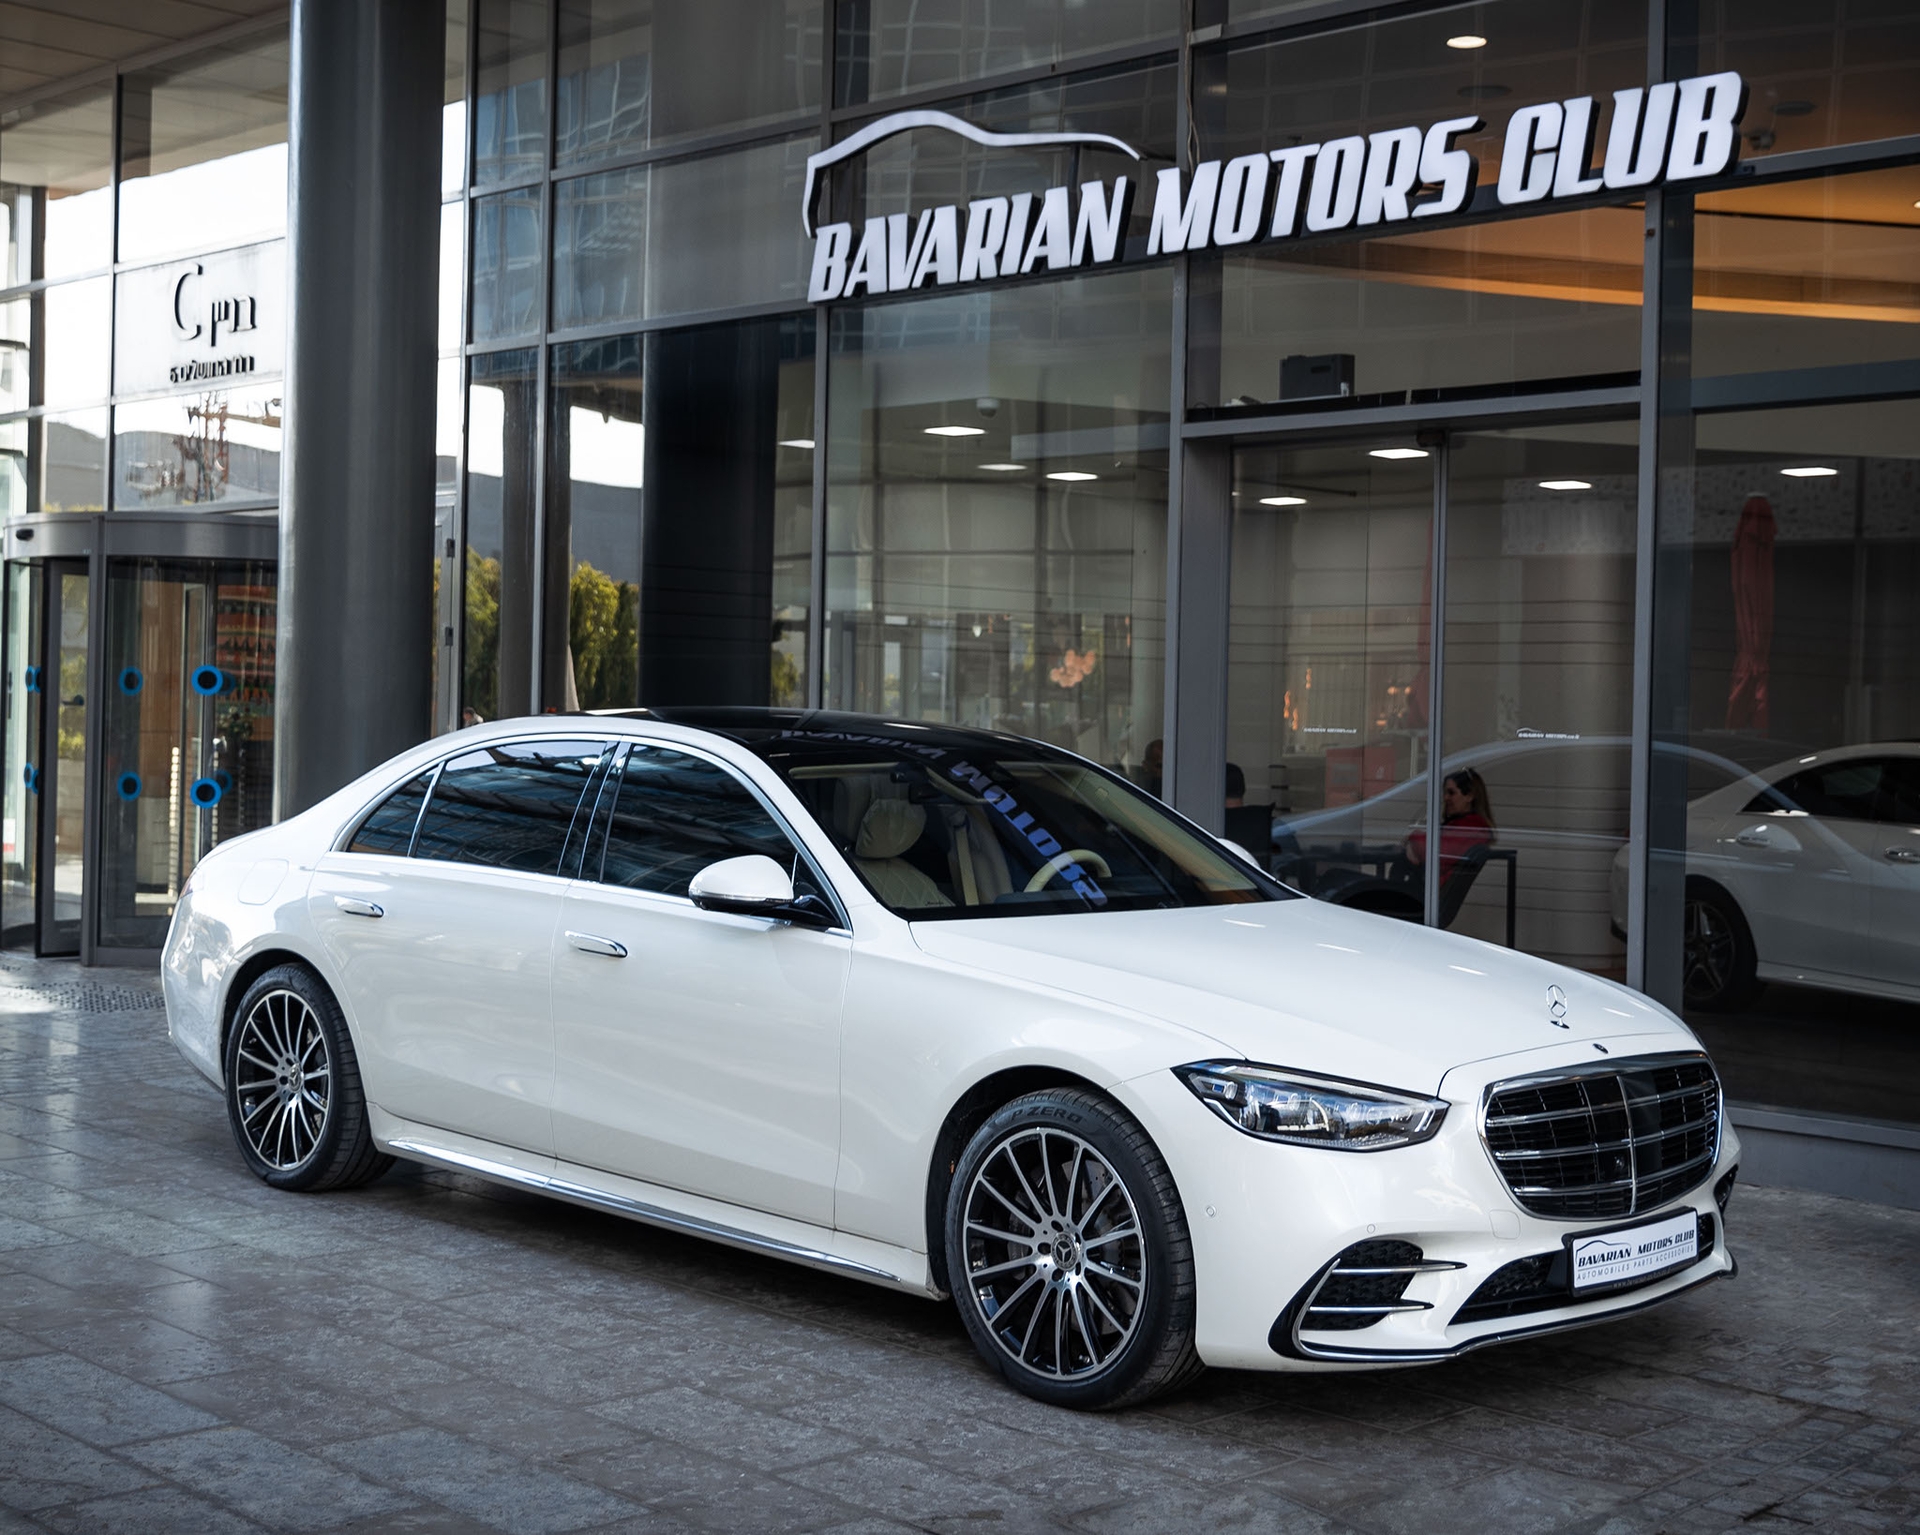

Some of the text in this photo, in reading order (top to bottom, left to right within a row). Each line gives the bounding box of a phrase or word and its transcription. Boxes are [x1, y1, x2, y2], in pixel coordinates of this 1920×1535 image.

[807, 71, 1744, 303] BAVARIAN MOTORS CLUB
[172, 263, 203, 341] C
[1011, 1106, 1083, 1123] P ZERO
[1578, 1229, 1694, 1267] BAVARIAN MOTORS CLUB
[1577, 1263, 1630, 1280] AUTOMOBILES
[1633, 1258, 1653, 1269] PARTS
